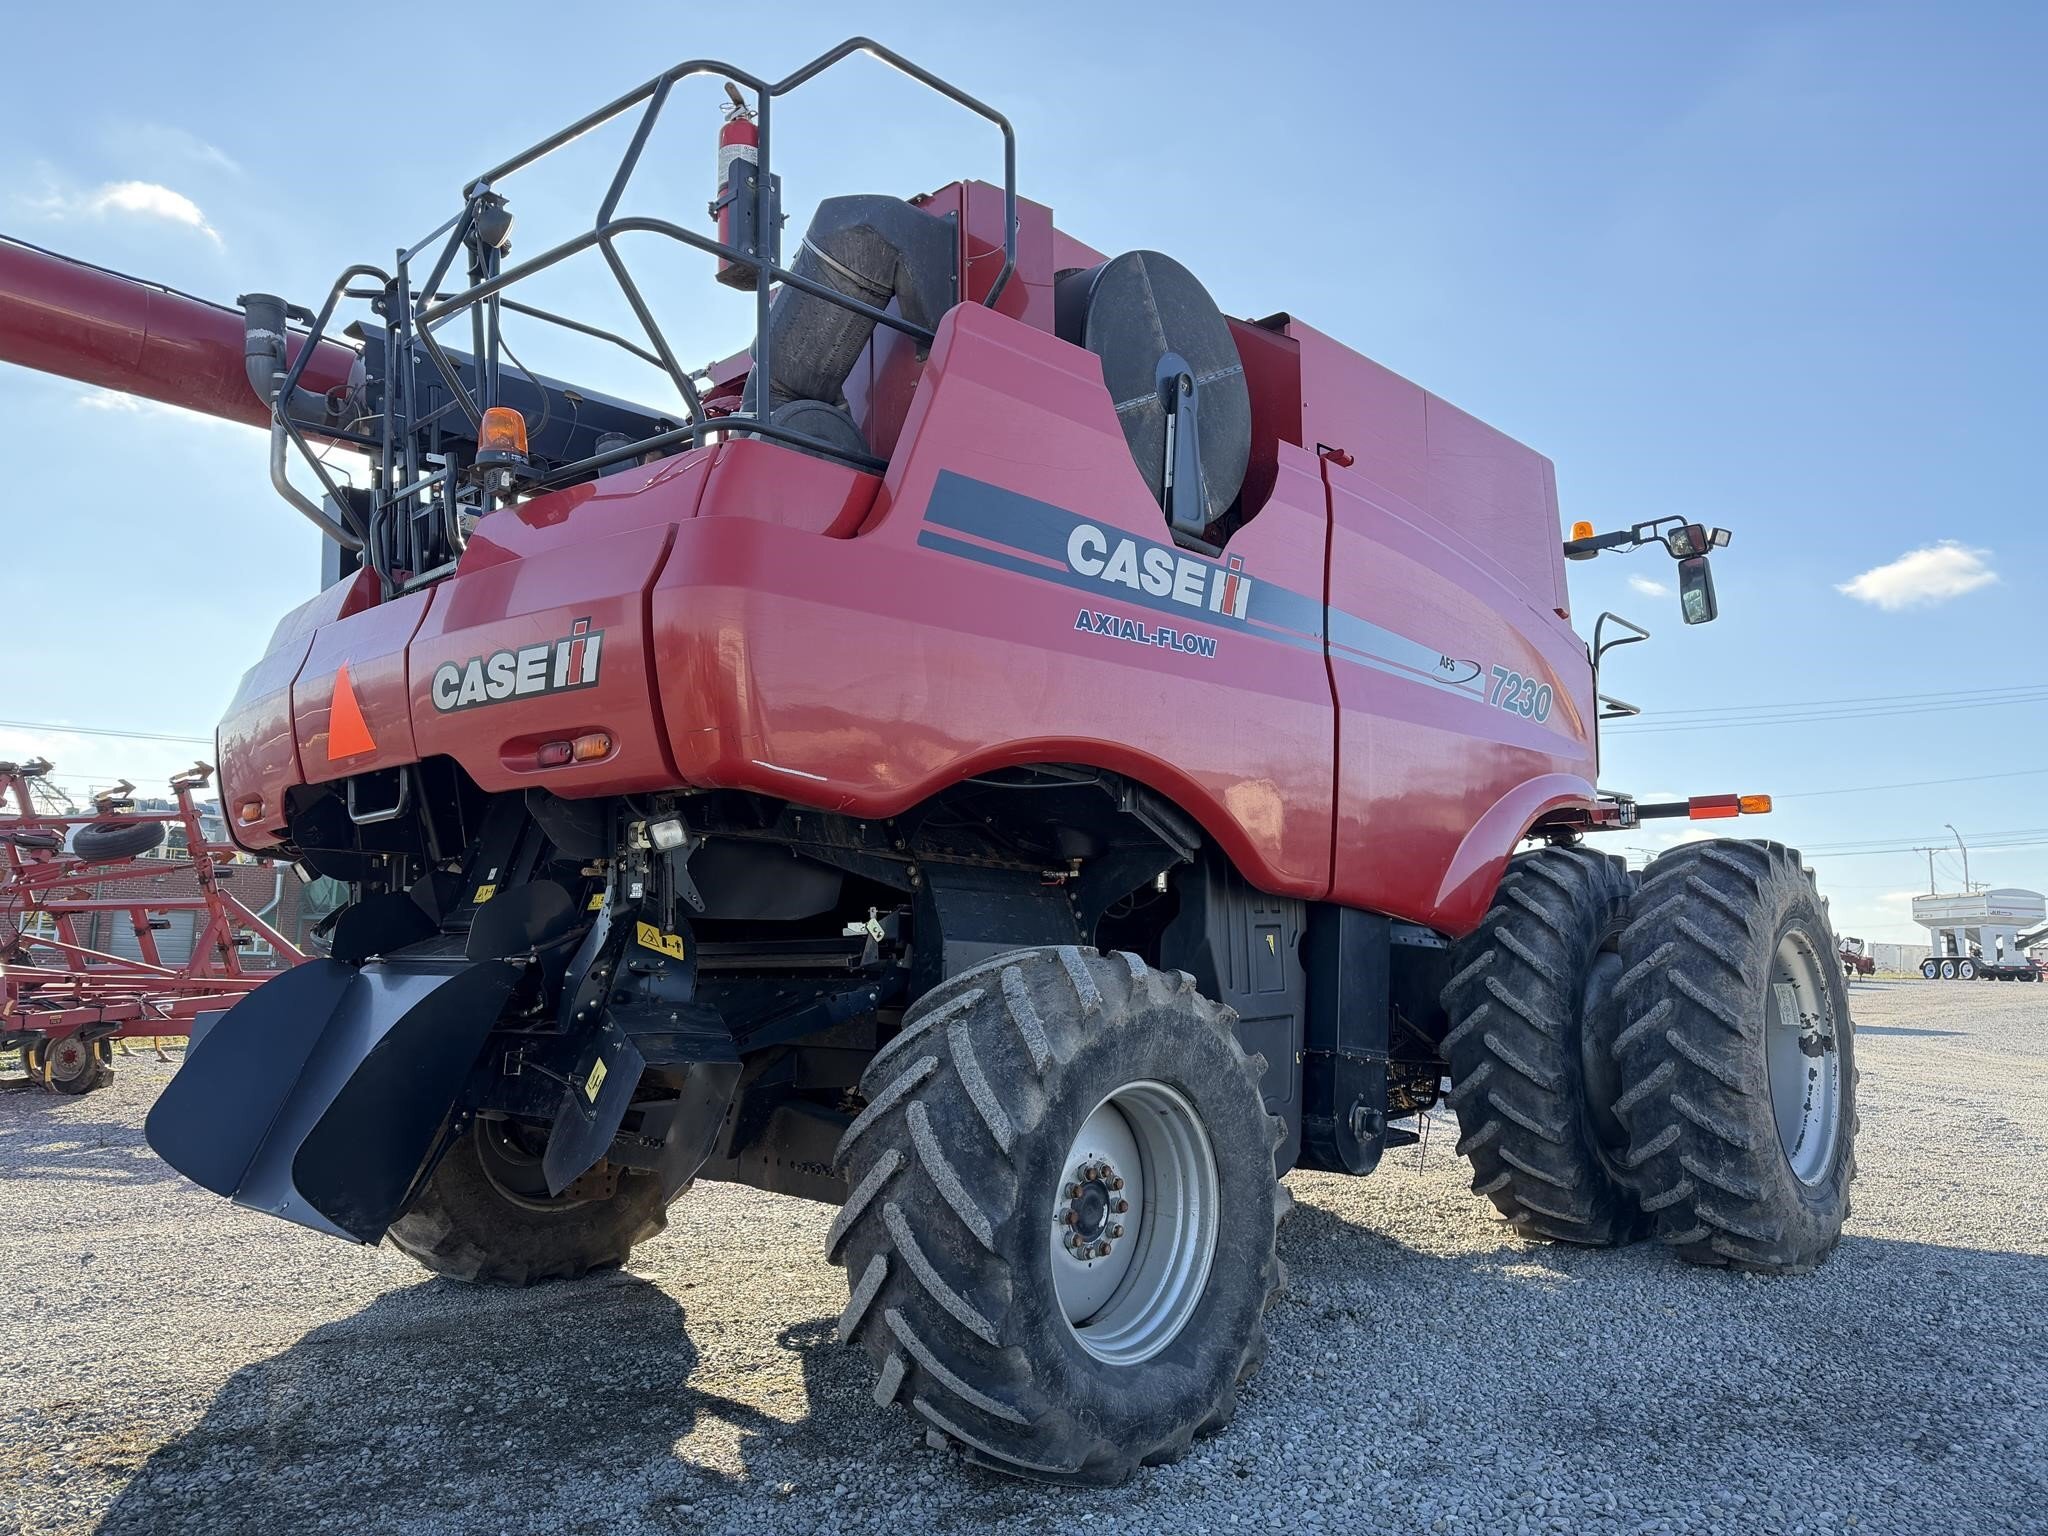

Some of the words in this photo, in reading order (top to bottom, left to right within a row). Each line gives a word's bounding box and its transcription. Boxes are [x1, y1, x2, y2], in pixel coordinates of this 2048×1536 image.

[1067, 524, 1207, 607] CASE
[1074, 609, 1218, 659] AXIAL-FLOW
[1439, 655, 1456, 672] AFS
[432, 645, 549, 710] CASE
[1490, 663, 1553, 724] 7230
